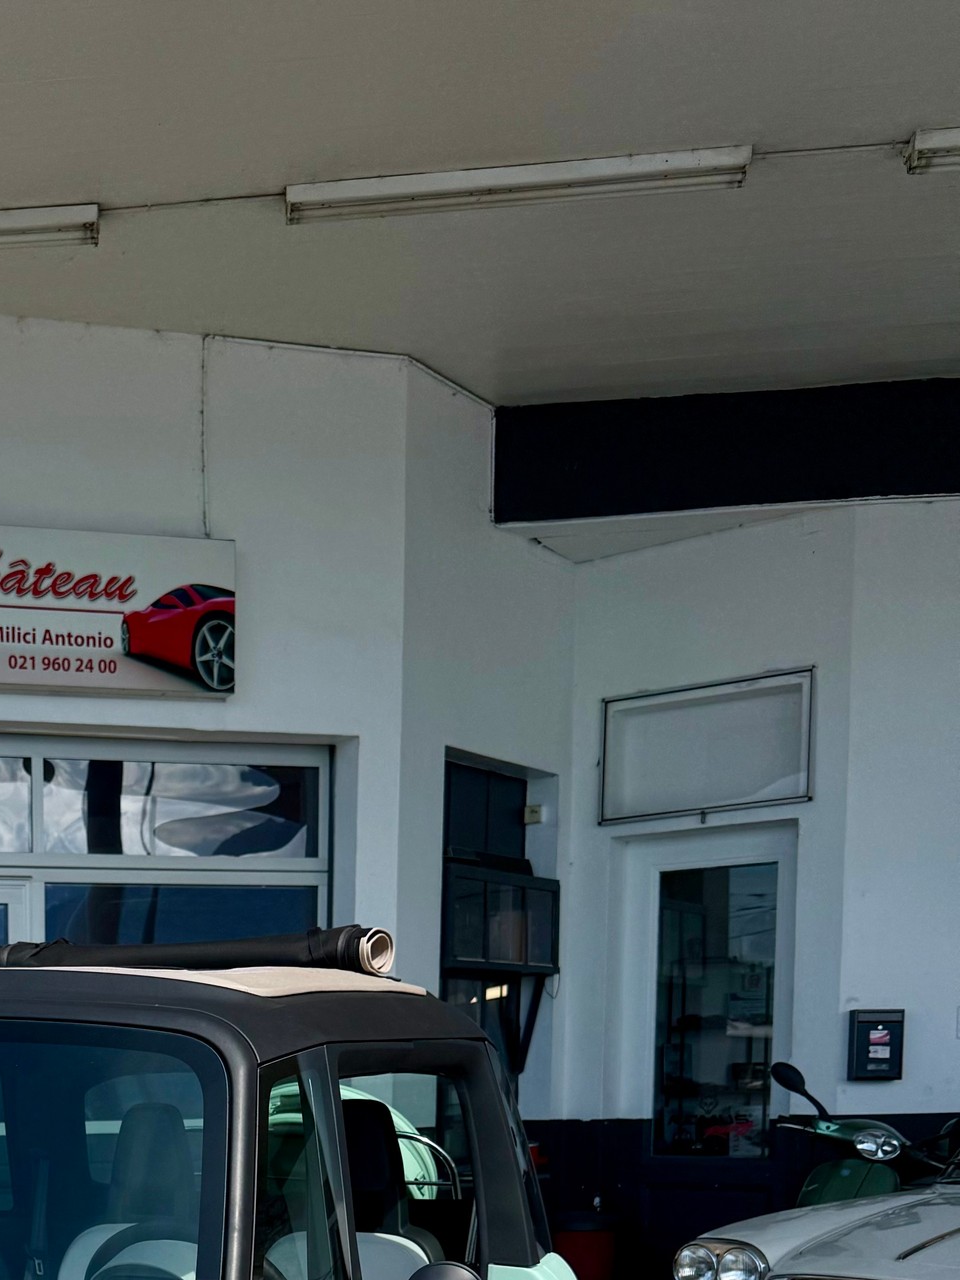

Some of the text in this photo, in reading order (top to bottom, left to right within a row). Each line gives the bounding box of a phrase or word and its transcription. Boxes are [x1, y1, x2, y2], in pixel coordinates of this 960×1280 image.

[41, 628, 114, 649] Antonio
[8, 653, 36, 671] 021
[41, 655, 71, 673] 960
[75, 656, 95, 673] 24
[98, 658, 117, 674] 00
